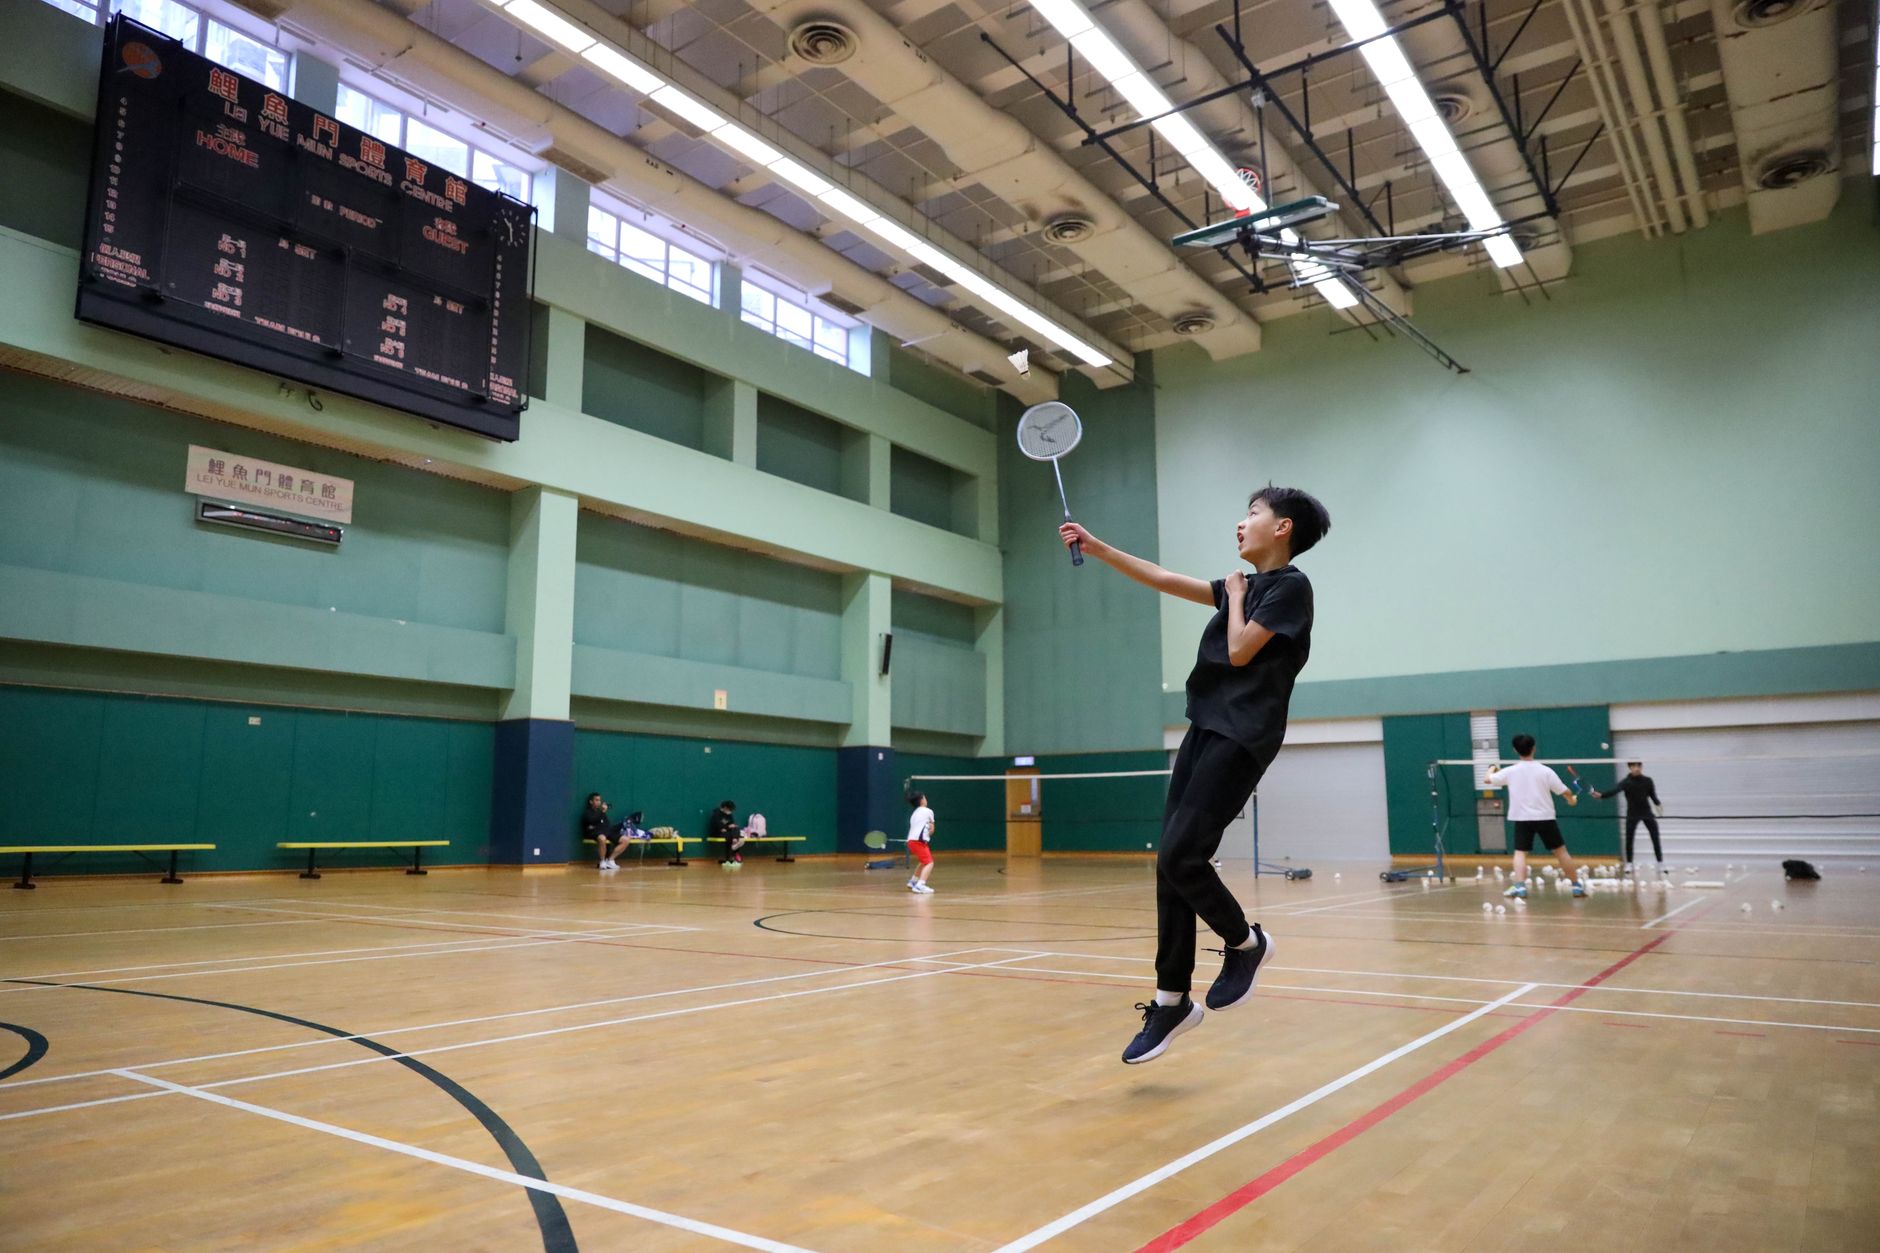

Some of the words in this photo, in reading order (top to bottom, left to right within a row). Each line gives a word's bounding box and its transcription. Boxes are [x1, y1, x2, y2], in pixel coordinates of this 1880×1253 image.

[196, 129, 260, 169] HOME
[208, 67, 468, 207] 鯉魚門體育館
[258, 115, 290, 141] YUE
[297, 132, 333, 160] MUN
[338, 152, 393, 187] SPORTS
[400, 180, 453, 213] CENTRE
[422, 225, 470, 255] GUEST
[196, 473, 214, 484] LEI
[216, 476, 238, 489] YUE
[239, 482, 262, 495] MUN
[263, 486, 304, 503] SPORTS
[305, 495, 344, 511] CENTRE
[207, 457, 337, 500] 鯉魚門體育館
